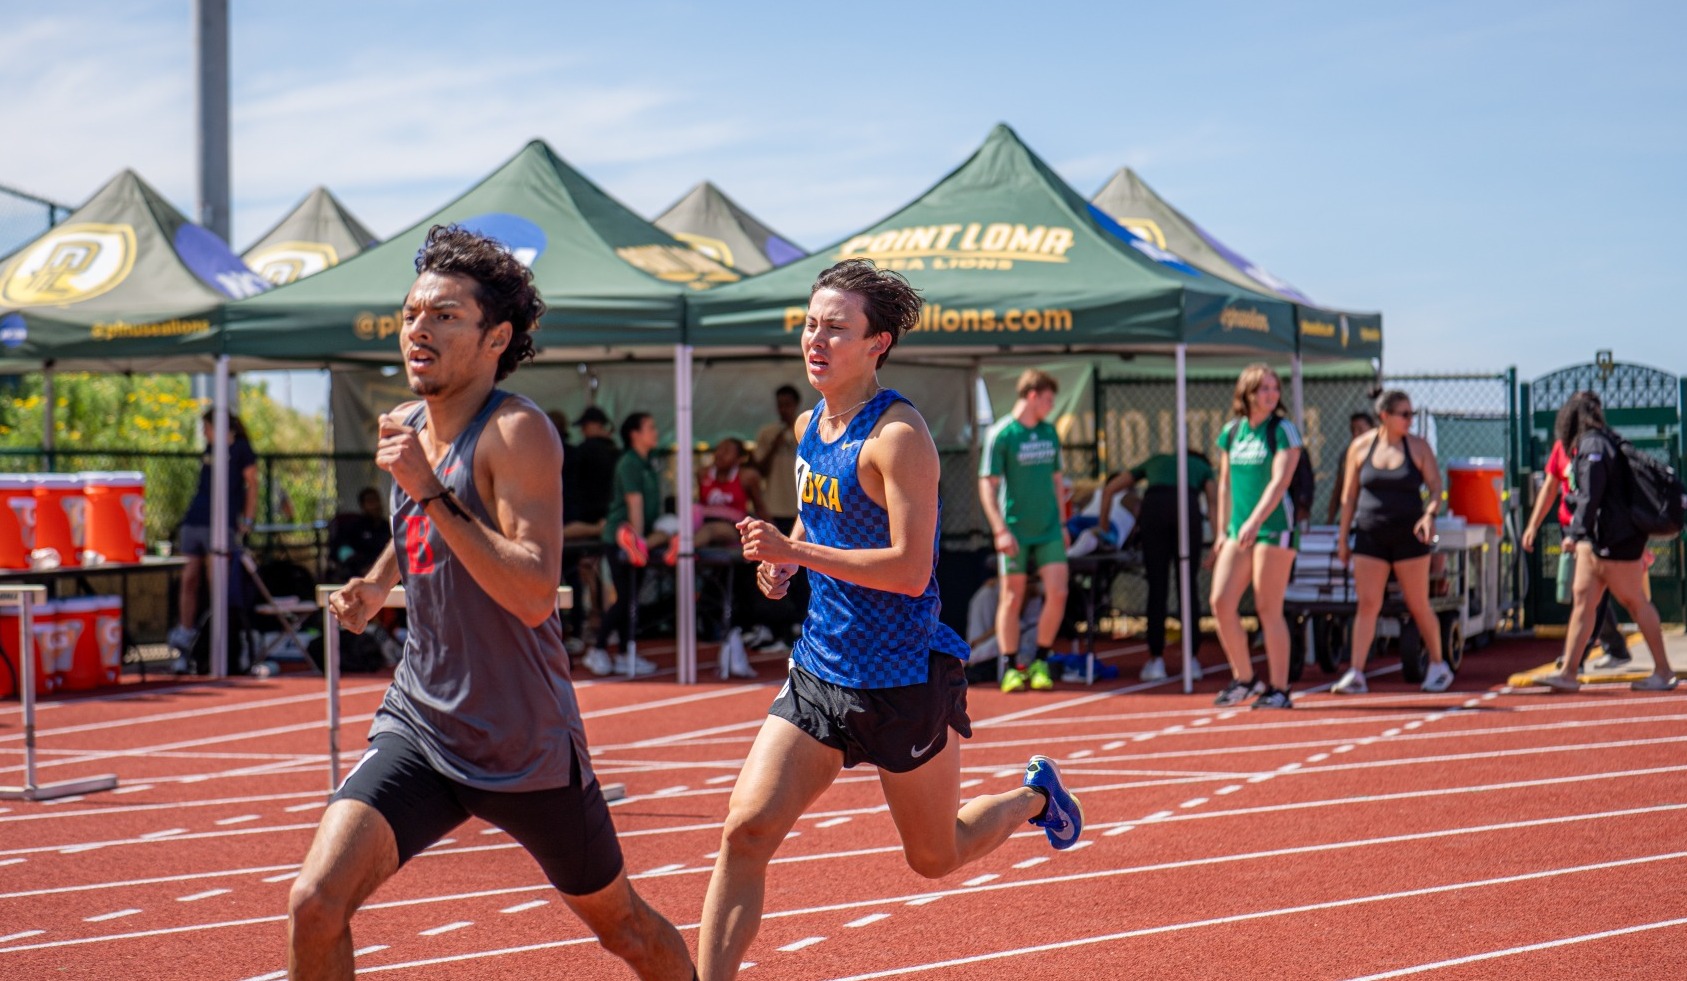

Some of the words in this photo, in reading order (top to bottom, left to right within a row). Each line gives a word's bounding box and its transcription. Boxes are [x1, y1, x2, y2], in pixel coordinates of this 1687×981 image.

[841, 224, 962, 256] POINT
[959, 223, 1075, 255] LOMA
[932, 257, 1014, 271] LIONS
[802, 471, 843, 513] OKA
